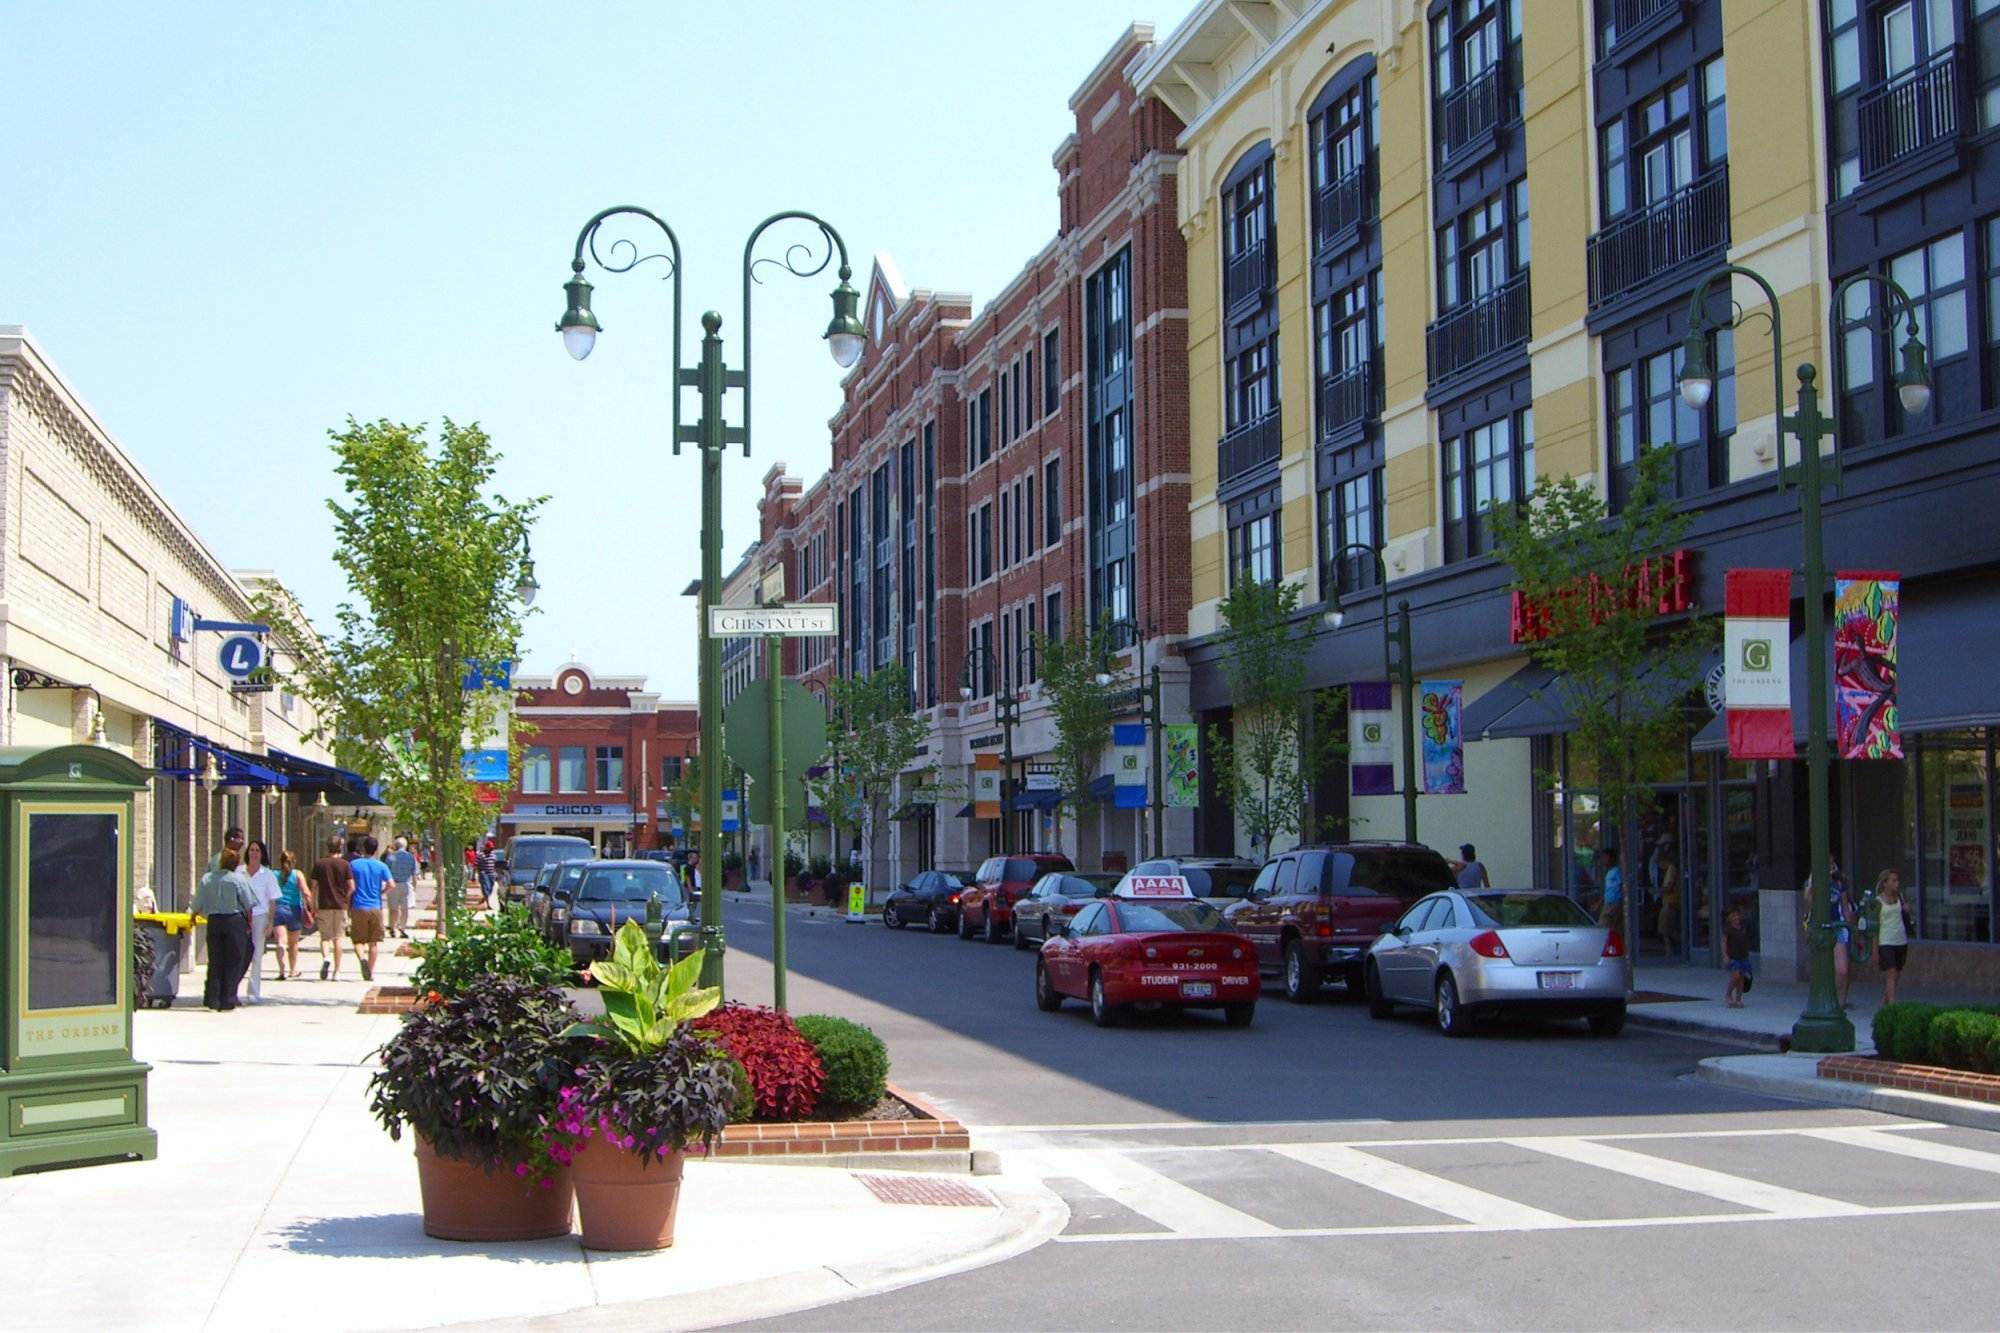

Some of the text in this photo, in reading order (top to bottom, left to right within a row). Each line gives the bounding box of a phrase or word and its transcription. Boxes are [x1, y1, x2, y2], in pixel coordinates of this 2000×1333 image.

[721, 616, 824, 630] CHESTNUT ST
[230, 644, 249, 670] L
[1746, 642, 1767, 668] G
[1364, 724, 1379, 741] G
[545, 804, 603, 815] CHICO'S
[1134, 878, 1182, 890] AAAA
[1141, 975, 1249, 985] STUDENT DRIVER
[27, 1024, 119, 1042] THE GREENE
